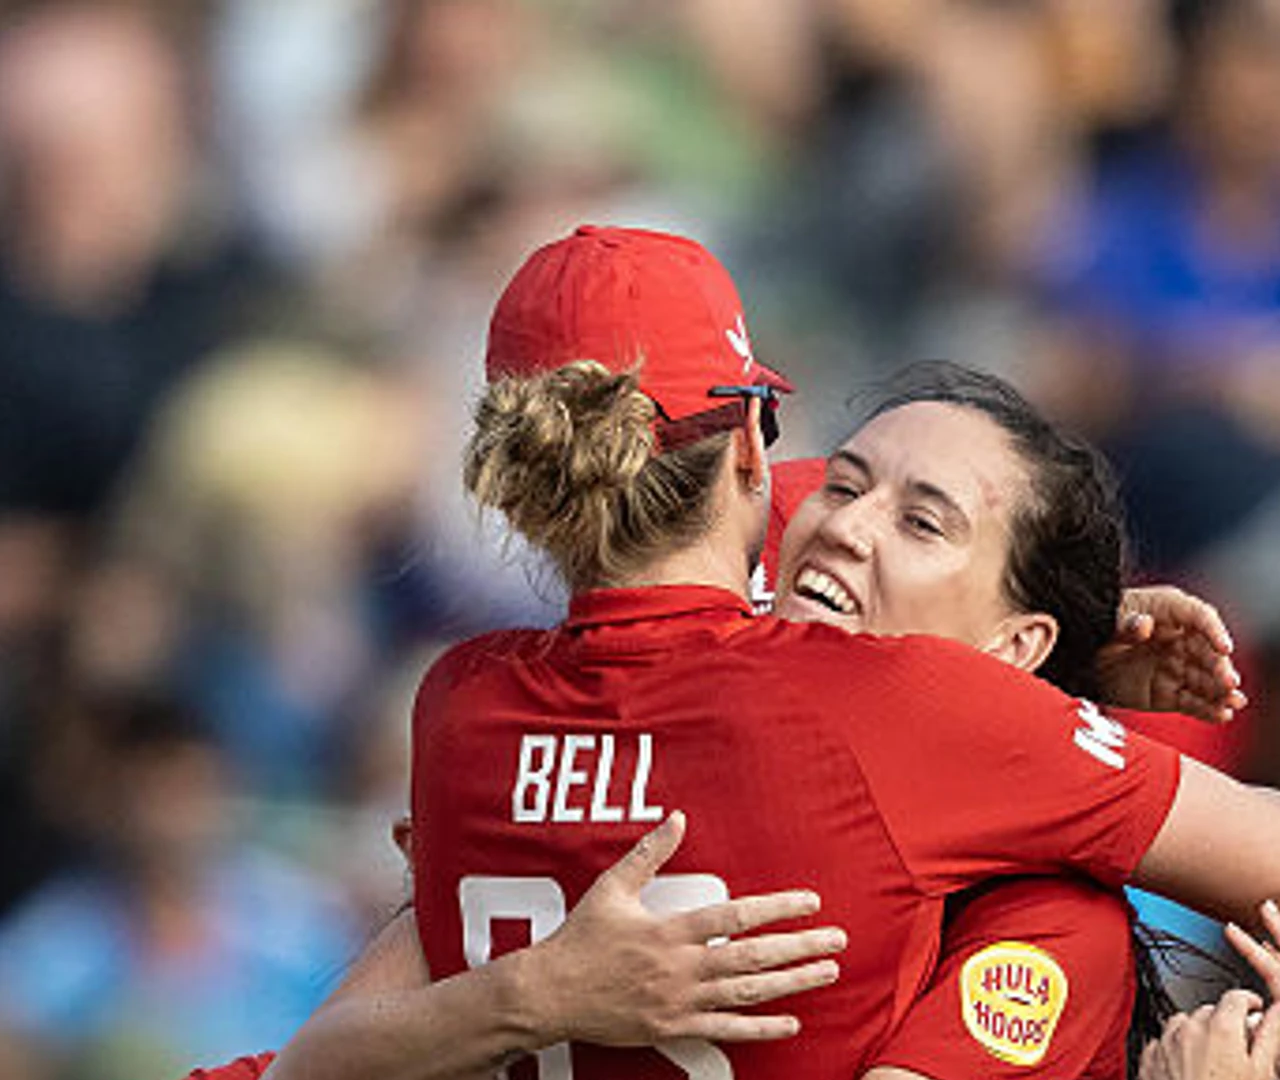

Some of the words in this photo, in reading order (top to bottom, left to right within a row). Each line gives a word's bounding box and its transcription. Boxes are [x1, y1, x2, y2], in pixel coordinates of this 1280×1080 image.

[511, 733, 664, 822] BELL
[981, 963, 1050, 1006] HULA
[973, 1000, 1050, 1047] HOOPS
